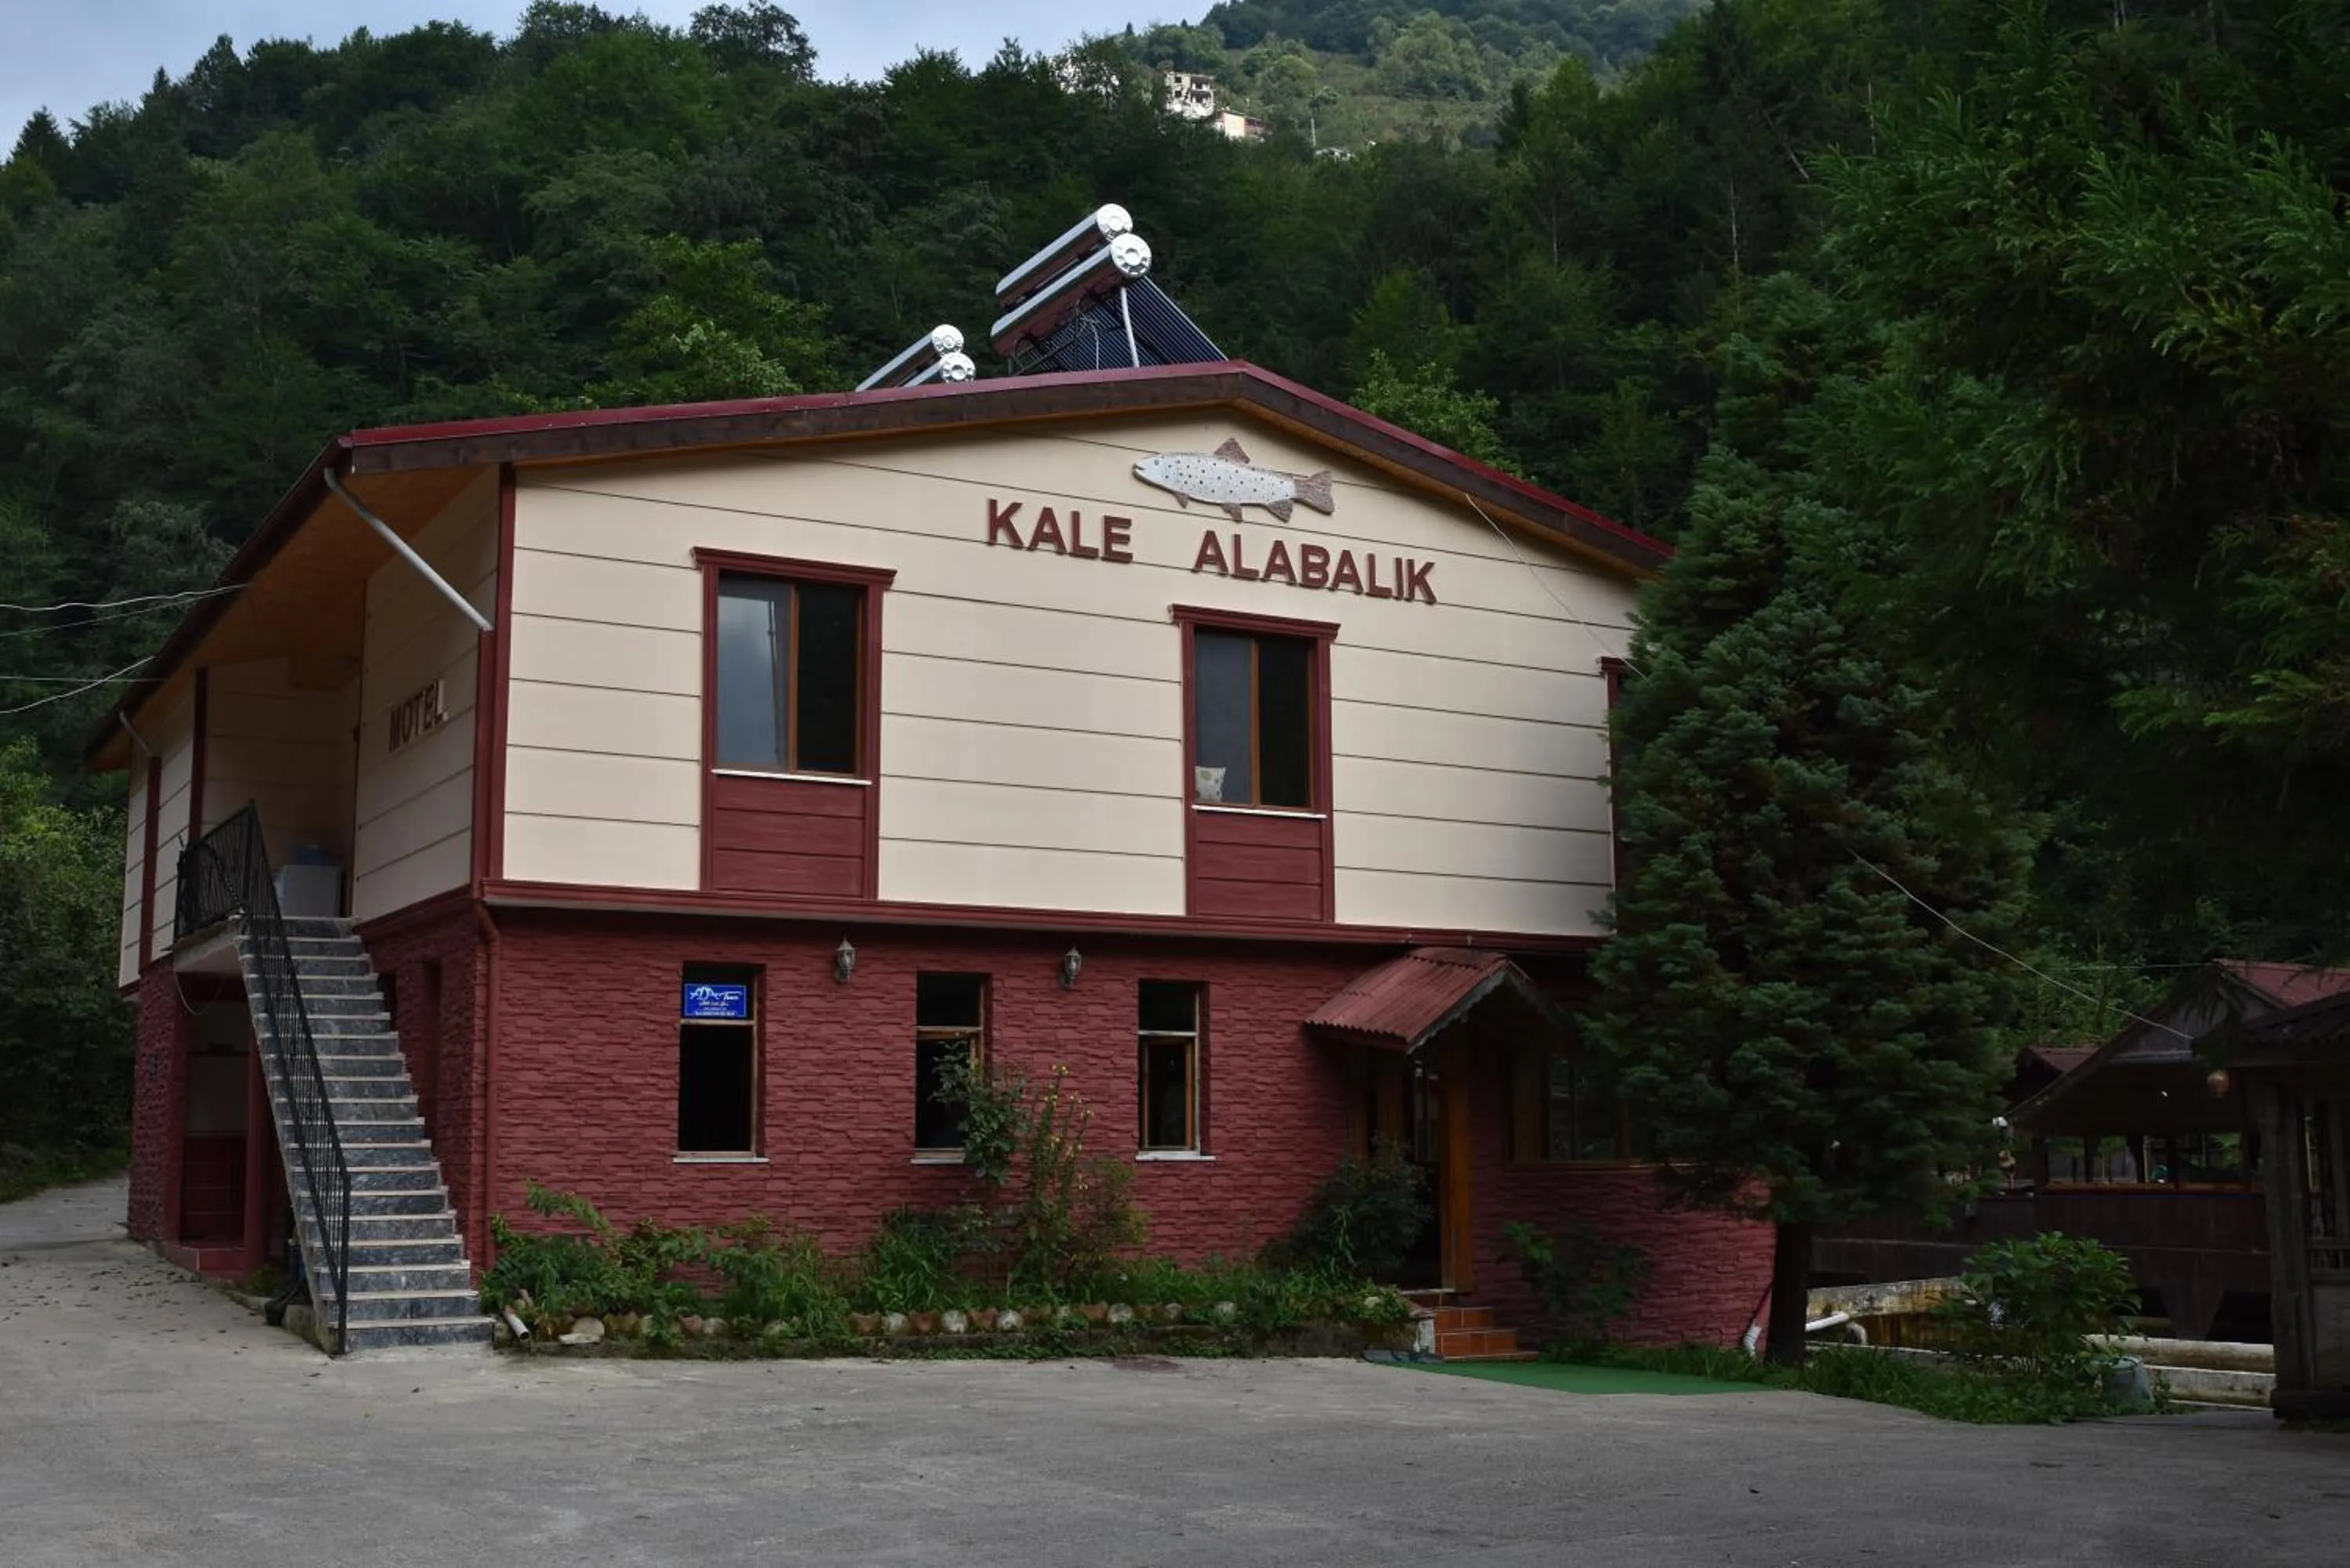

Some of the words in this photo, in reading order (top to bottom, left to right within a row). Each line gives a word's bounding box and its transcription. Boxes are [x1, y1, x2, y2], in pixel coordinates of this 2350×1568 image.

[987, 499, 1133, 563] KALE
[1192, 530, 1437, 604] ALABALIK
[389, 679, 446, 752] MOTEL
